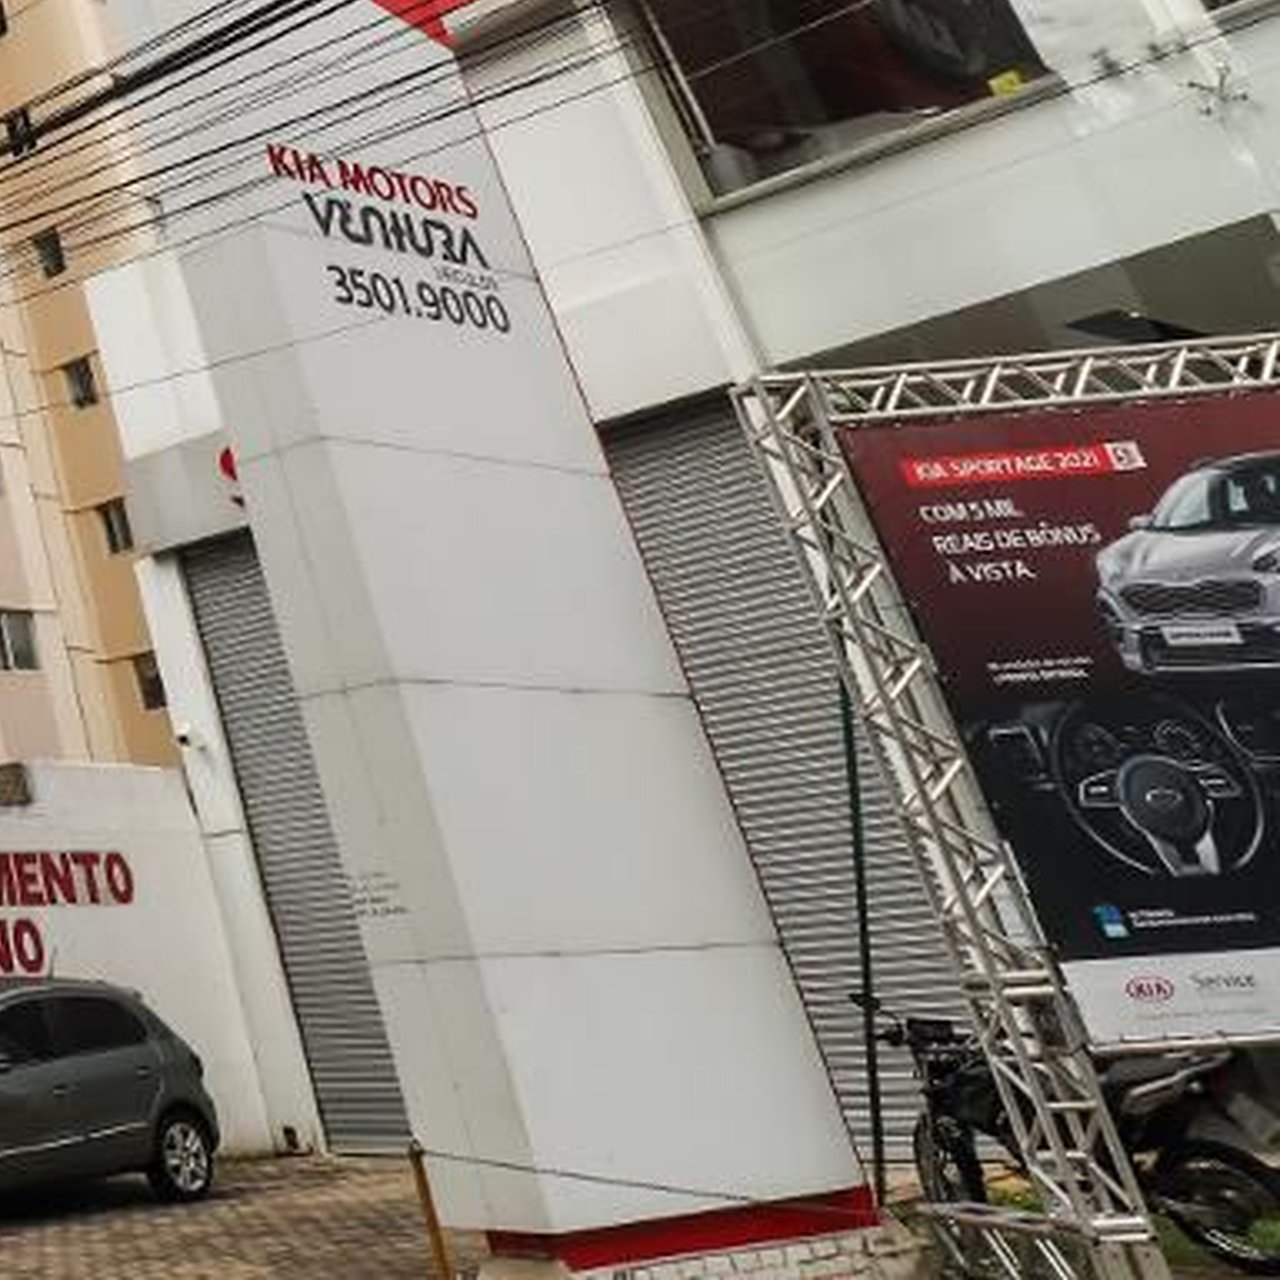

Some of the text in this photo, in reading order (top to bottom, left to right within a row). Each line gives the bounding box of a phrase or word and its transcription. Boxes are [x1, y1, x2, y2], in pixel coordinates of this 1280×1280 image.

[267, 143, 479, 220] KIA MOTORS
[326, 265, 511, 334] 3501.9000
[993, 529, 1028, 549] DE
